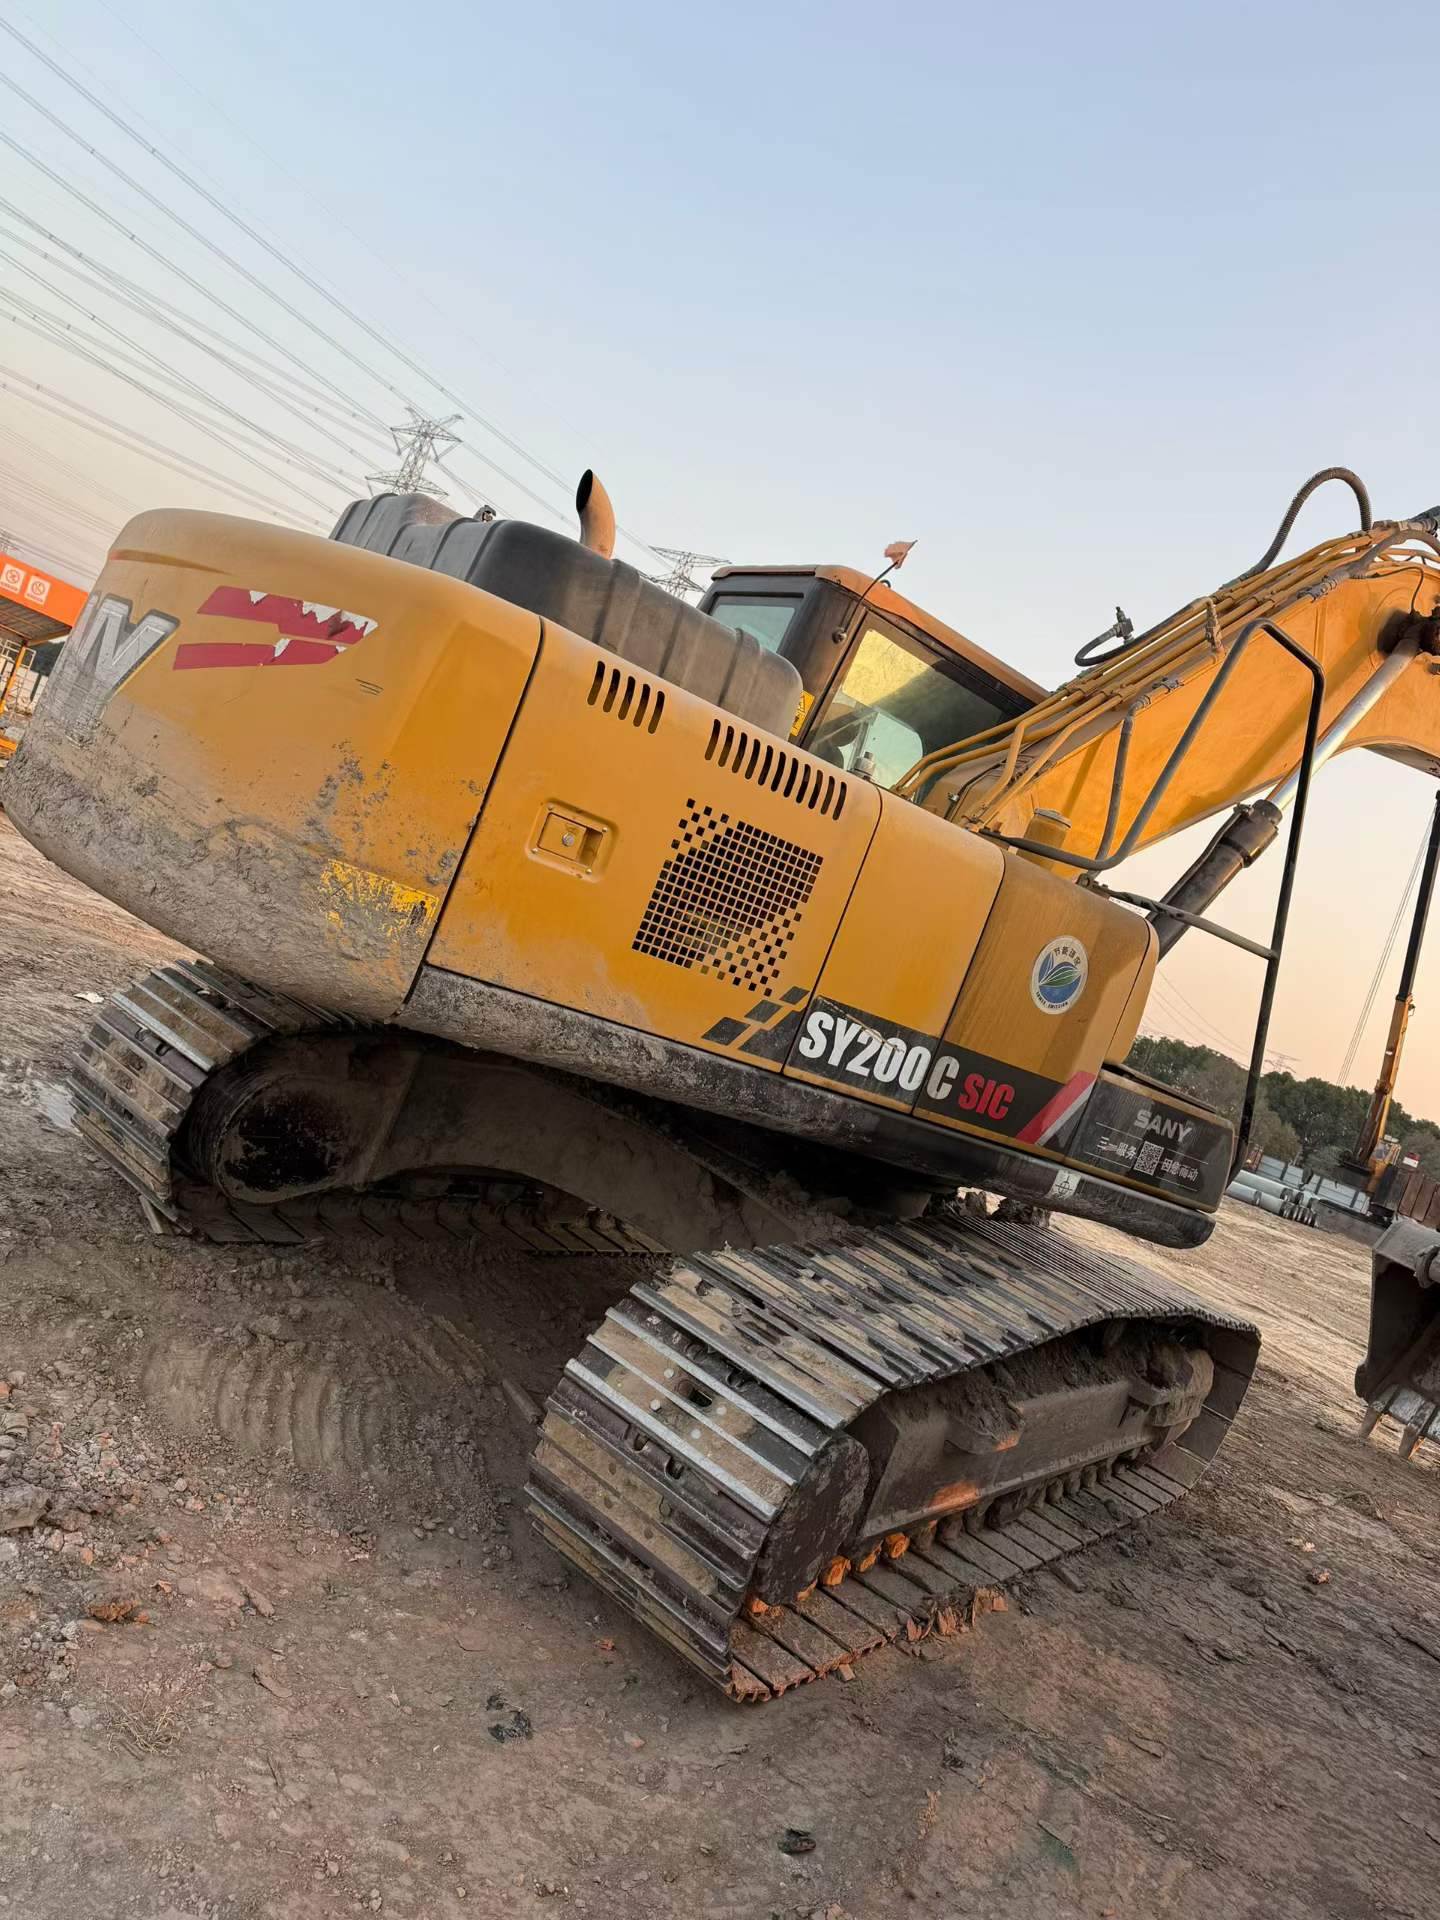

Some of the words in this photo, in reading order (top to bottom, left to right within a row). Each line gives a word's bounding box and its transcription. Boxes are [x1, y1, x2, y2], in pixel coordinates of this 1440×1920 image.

[799, 1011, 958, 1099] SY200C
[958, 1073, 1016, 1120] SIC
[1134, 1109, 1193, 1142] SANY
[1097, 1136, 1137, 1160] 三一服务
